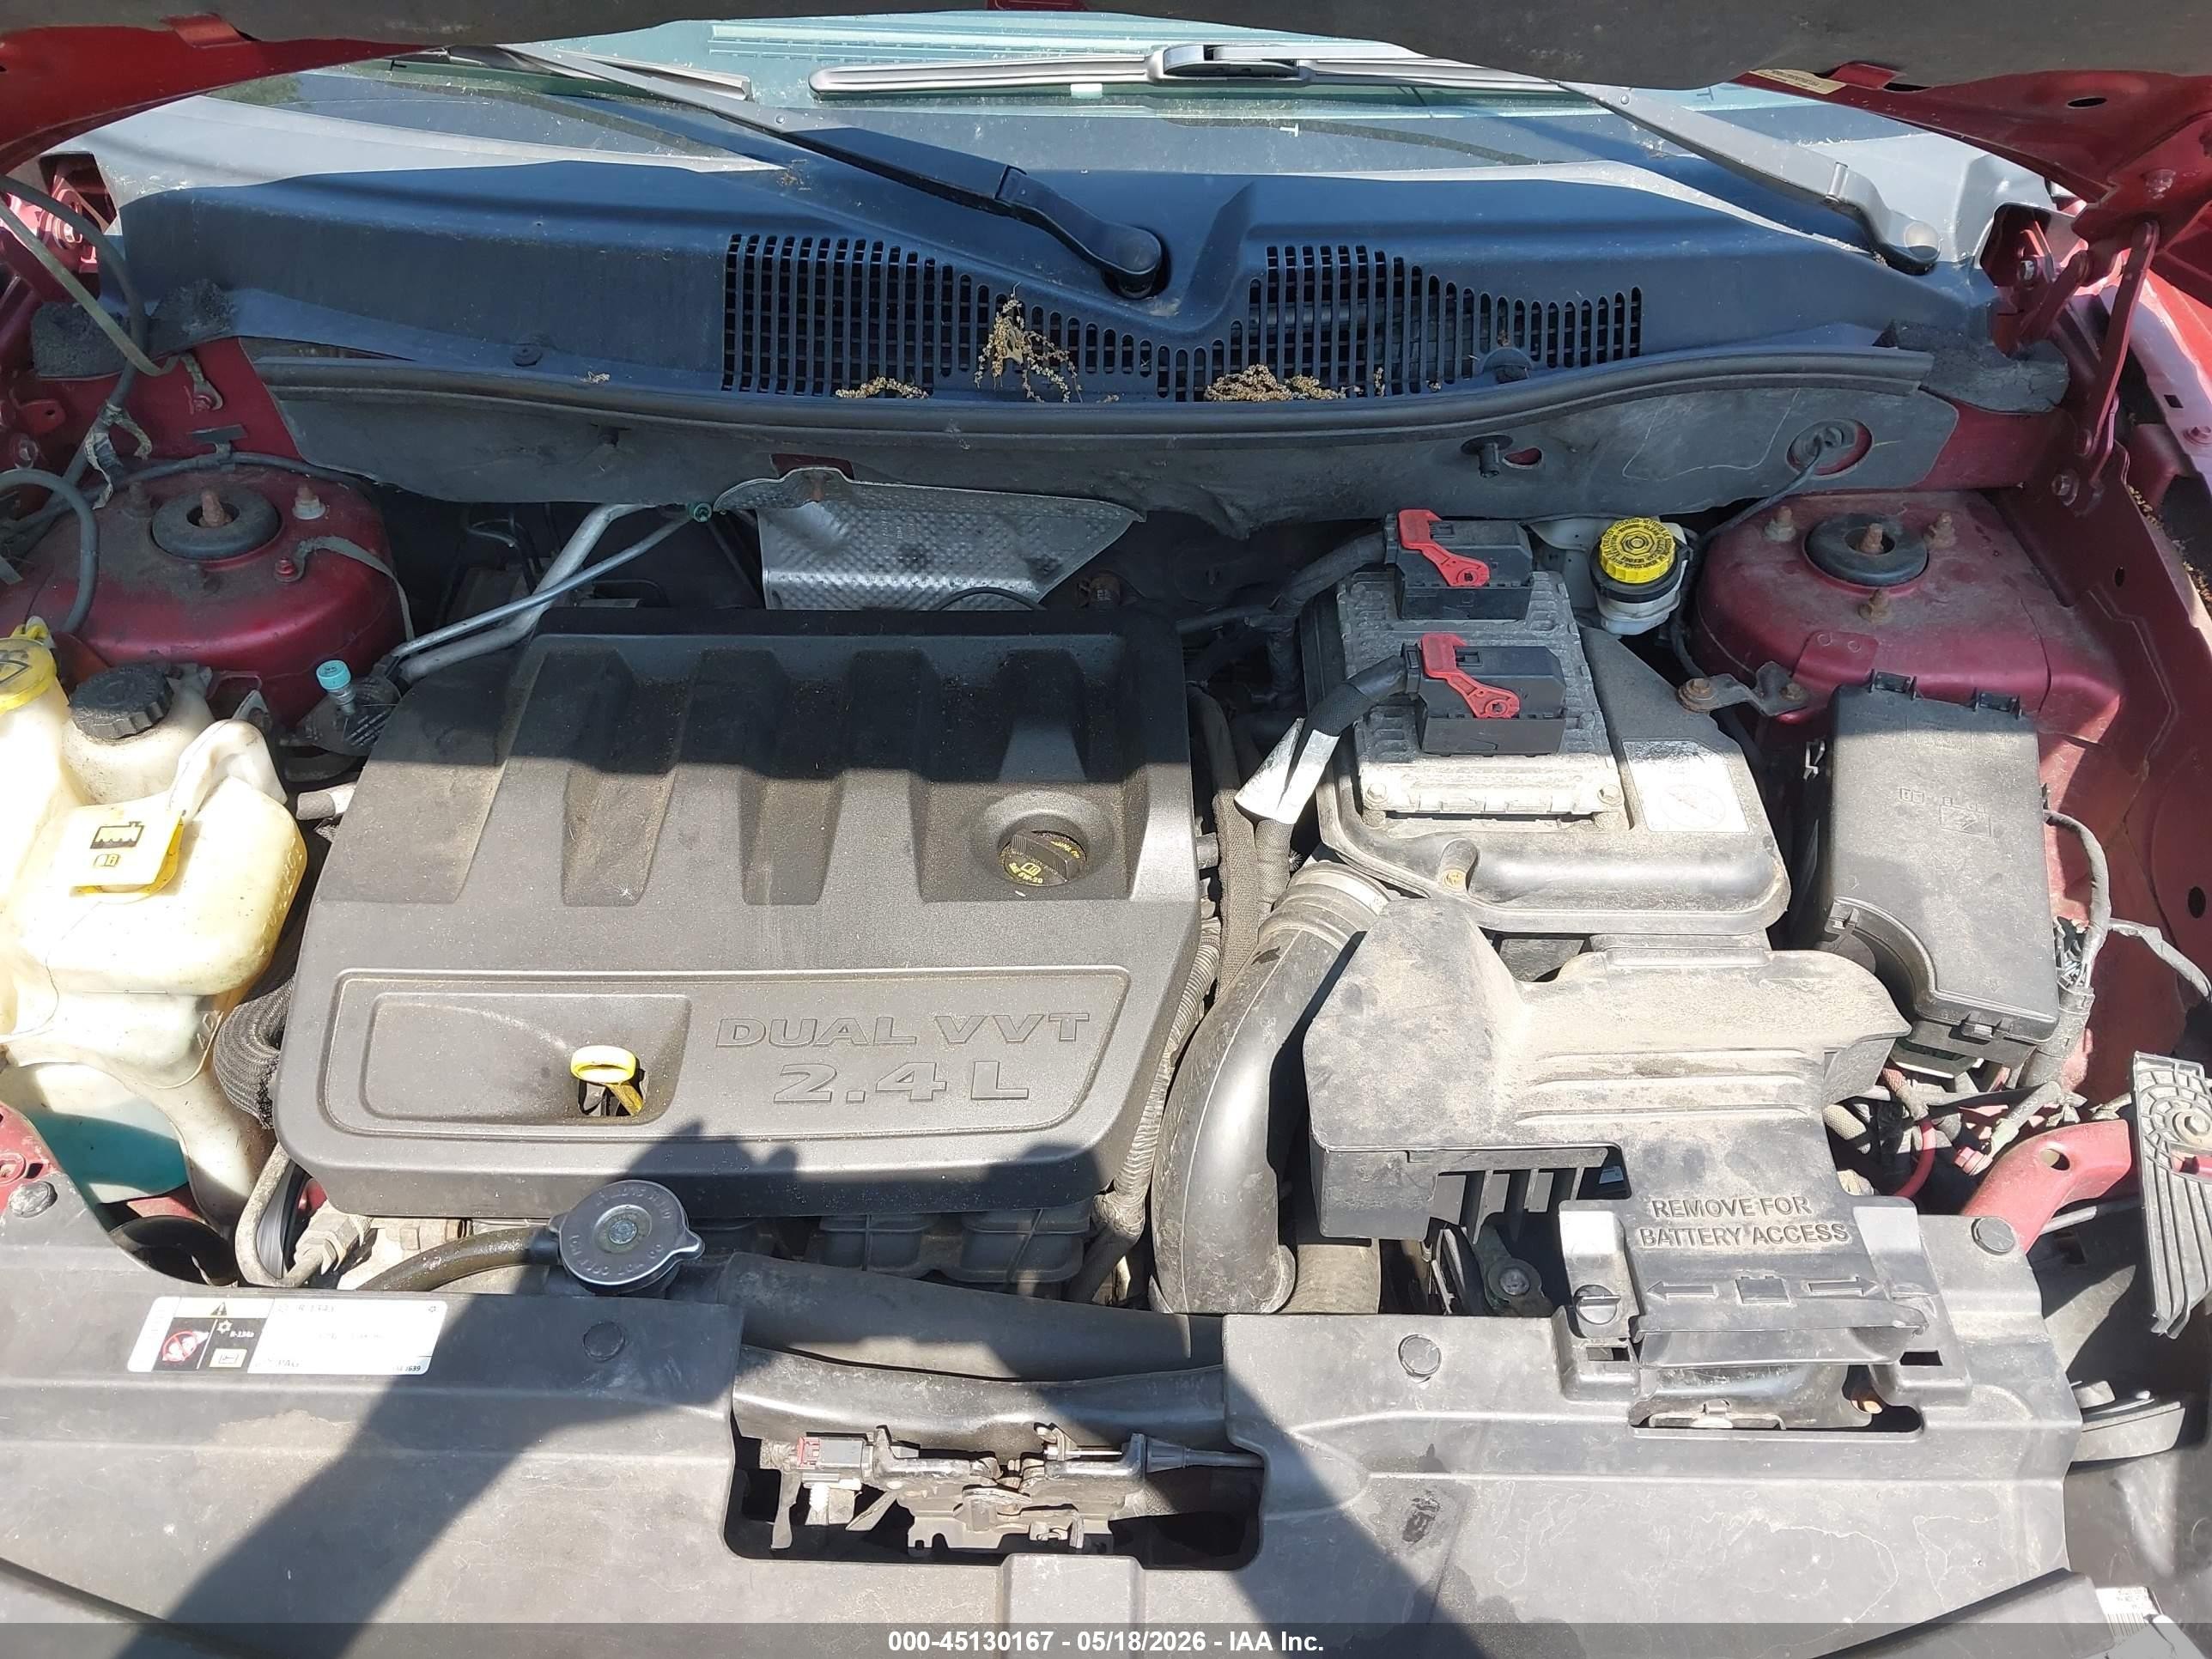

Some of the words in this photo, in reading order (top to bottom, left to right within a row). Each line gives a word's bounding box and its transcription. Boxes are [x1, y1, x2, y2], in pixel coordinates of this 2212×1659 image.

[716, 1017, 917, 1047] DUAL
[935, 1013, 1090, 1043] VVT
[1651, 1199, 1756, 1218] REMOVE
[1759, 1196, 1813, 1216] FOR
[1639, 1226, 1741, 1247] BATTERY
[1753, 1223, 1850, 1245] ACCESS
